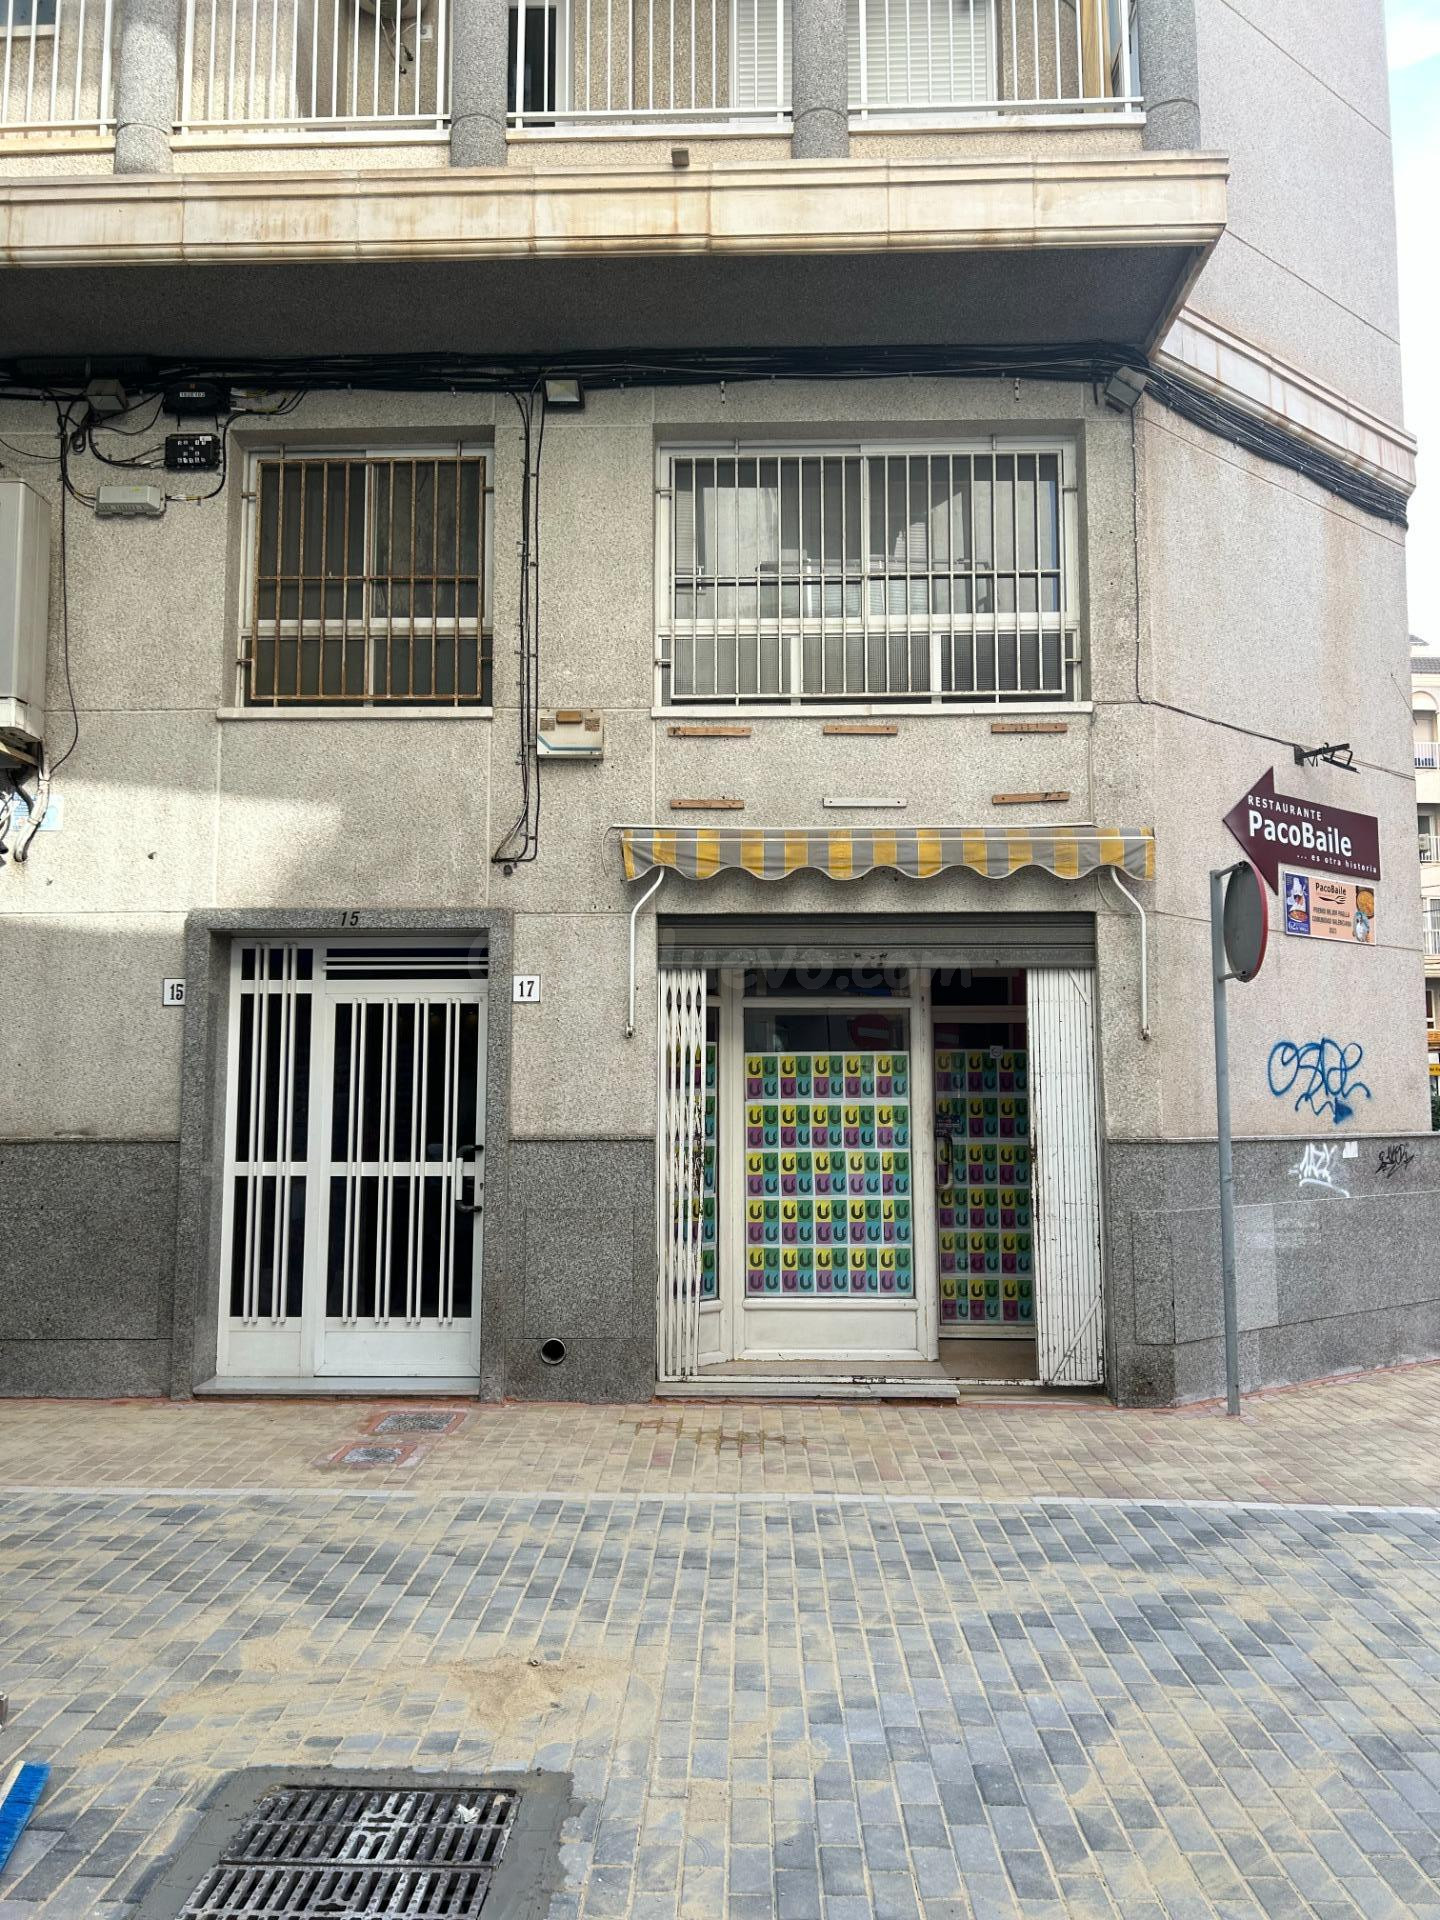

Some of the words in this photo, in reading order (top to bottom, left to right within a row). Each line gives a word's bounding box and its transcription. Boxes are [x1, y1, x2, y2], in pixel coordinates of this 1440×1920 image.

[1247, 794, 1322, 821] RESTAURANTE
[1248, 809, 1352, 857] PacoBaile
[1311, 854, 1321, 862] es
[1324, 856, 1342, 867] otra
[1345, 859, 1377, 874] historia
[1315, 882, 1347, 896] PacoBaile
[341, 911, 361, 926] 15
[170, 983, 184, 1001] 15
[519, 980, 535, 997] 17
